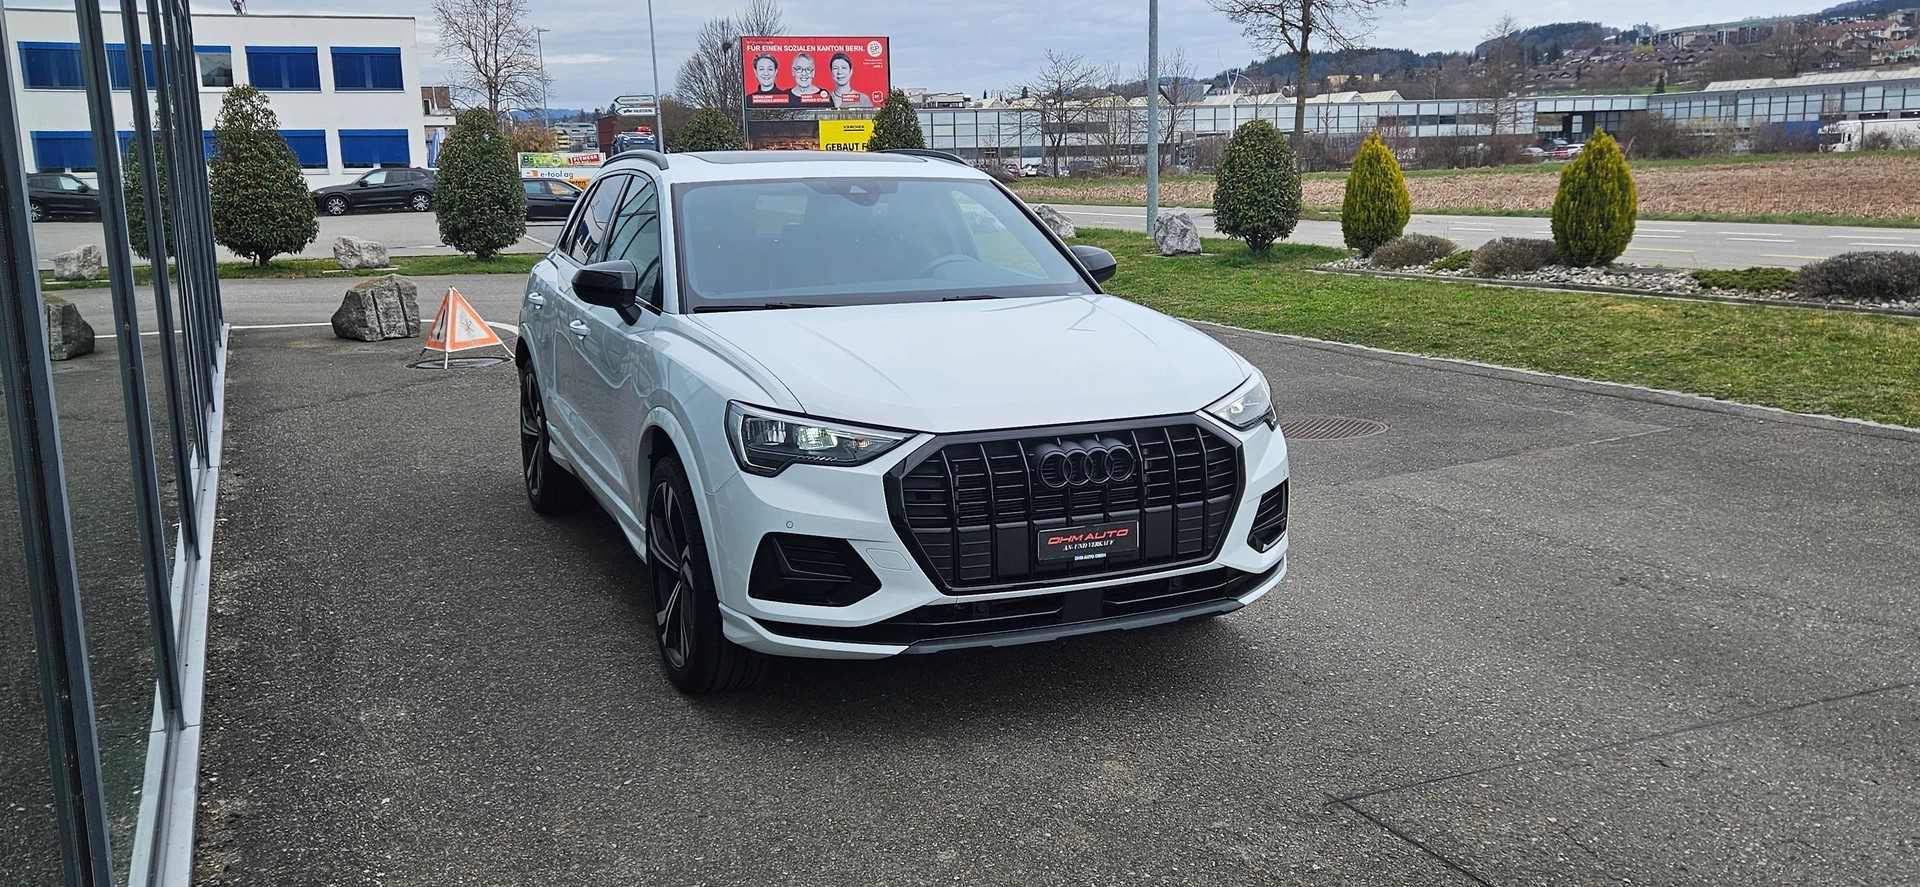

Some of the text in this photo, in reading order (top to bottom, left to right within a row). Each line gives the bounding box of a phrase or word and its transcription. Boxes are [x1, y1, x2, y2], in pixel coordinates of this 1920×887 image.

[747, 43, 760, 52] FÜR
[825, 142, 859, 151] GEBAUT
[540, 170, 562, 178] e-tool
[1047, 528, 1129, 545] DHM AUTO
